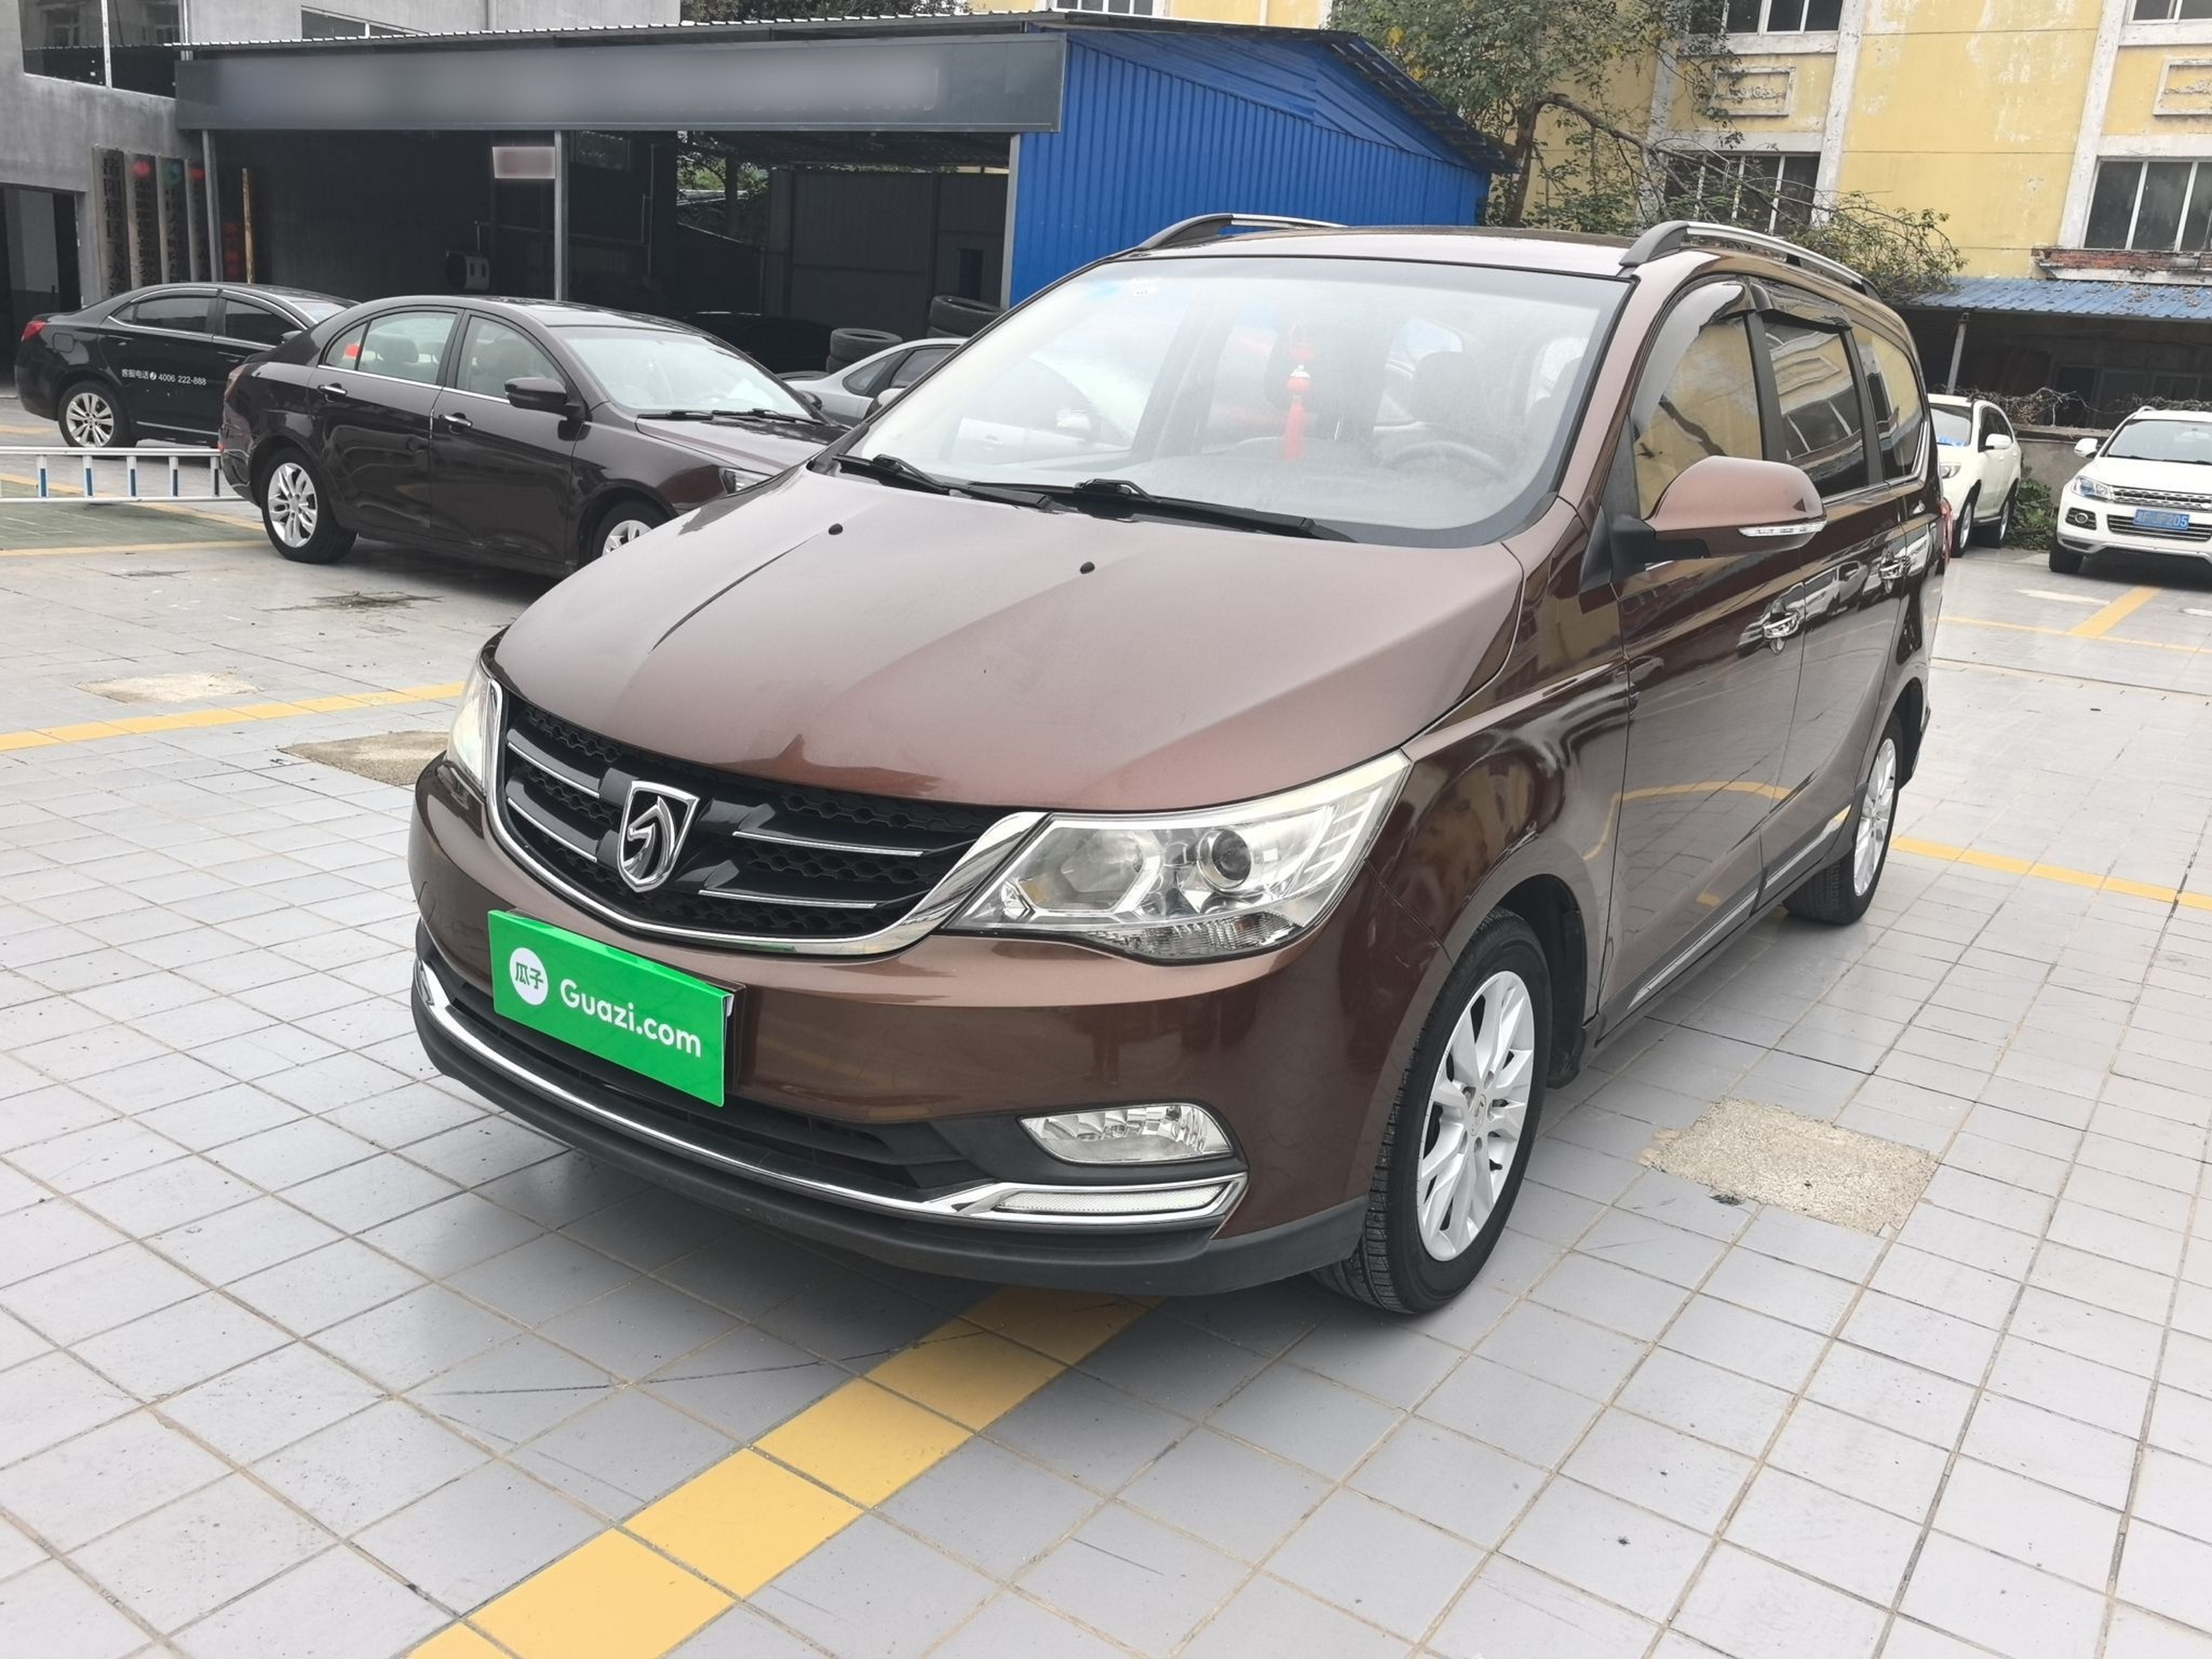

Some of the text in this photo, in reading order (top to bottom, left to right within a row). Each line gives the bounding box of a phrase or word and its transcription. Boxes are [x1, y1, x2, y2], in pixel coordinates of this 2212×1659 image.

[122, 369, 206, 385] 客服电话 4006 222-888
[516, 961, 544, 989] 瓜子
[560, 979, 702, 1058] Guazi.com
